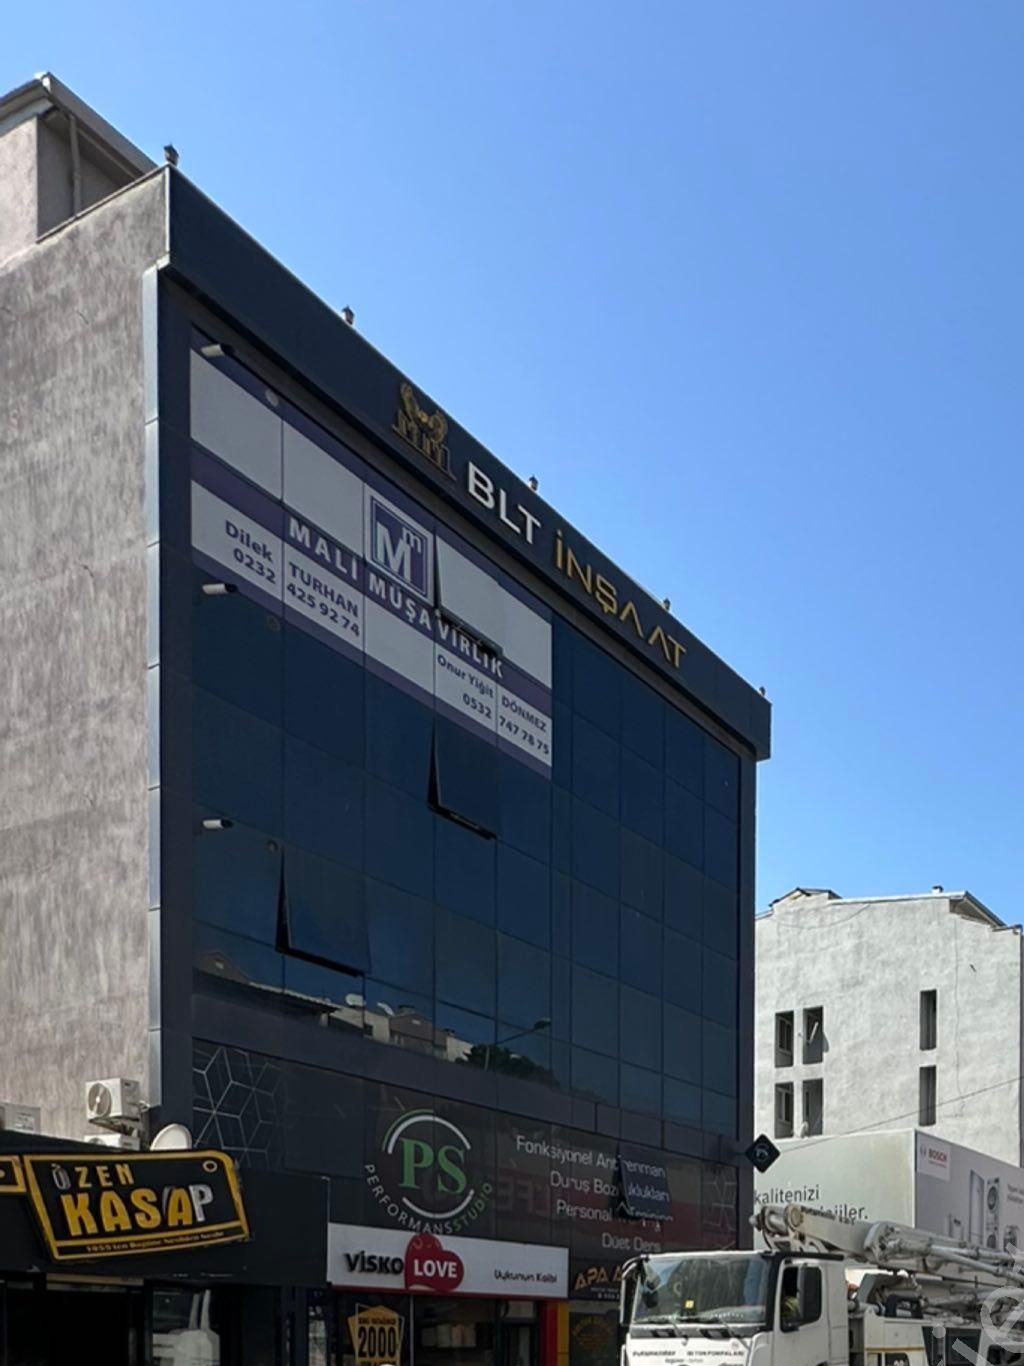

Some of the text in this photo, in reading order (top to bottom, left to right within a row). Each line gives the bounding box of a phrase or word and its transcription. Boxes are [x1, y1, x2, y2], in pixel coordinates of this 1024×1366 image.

[468, 461, 541, 544] BLT
[225, 520, 358, 618] Dilek TURHAN
[233, 547, 360, 637] 0232 425 92 74
[437, 654, 467, 680] Onur
[462, 693, 550, 755] 0532 747 78 75
[398, 1137, 467, 1194] PS
[516, 1135, 593, 1165] Fonksiyonel
[928, 1150, 948, 1163] BOSCH
[51, 1163, 135, 1190] ÖZEN
[364, 1164, 493, 1234] PERFORMANS STUDIO
[755, 1184, 820, 1204] kalitenizi
[60, 1183, 214, 1237] KASAP
[556, 1199, 613, 1222] Personal
[344, 1250, 458, 1279] VİSKO LOVE
[574, 1266, 609, 1291] APA
[358, 1326, 396, 1358] 2000
